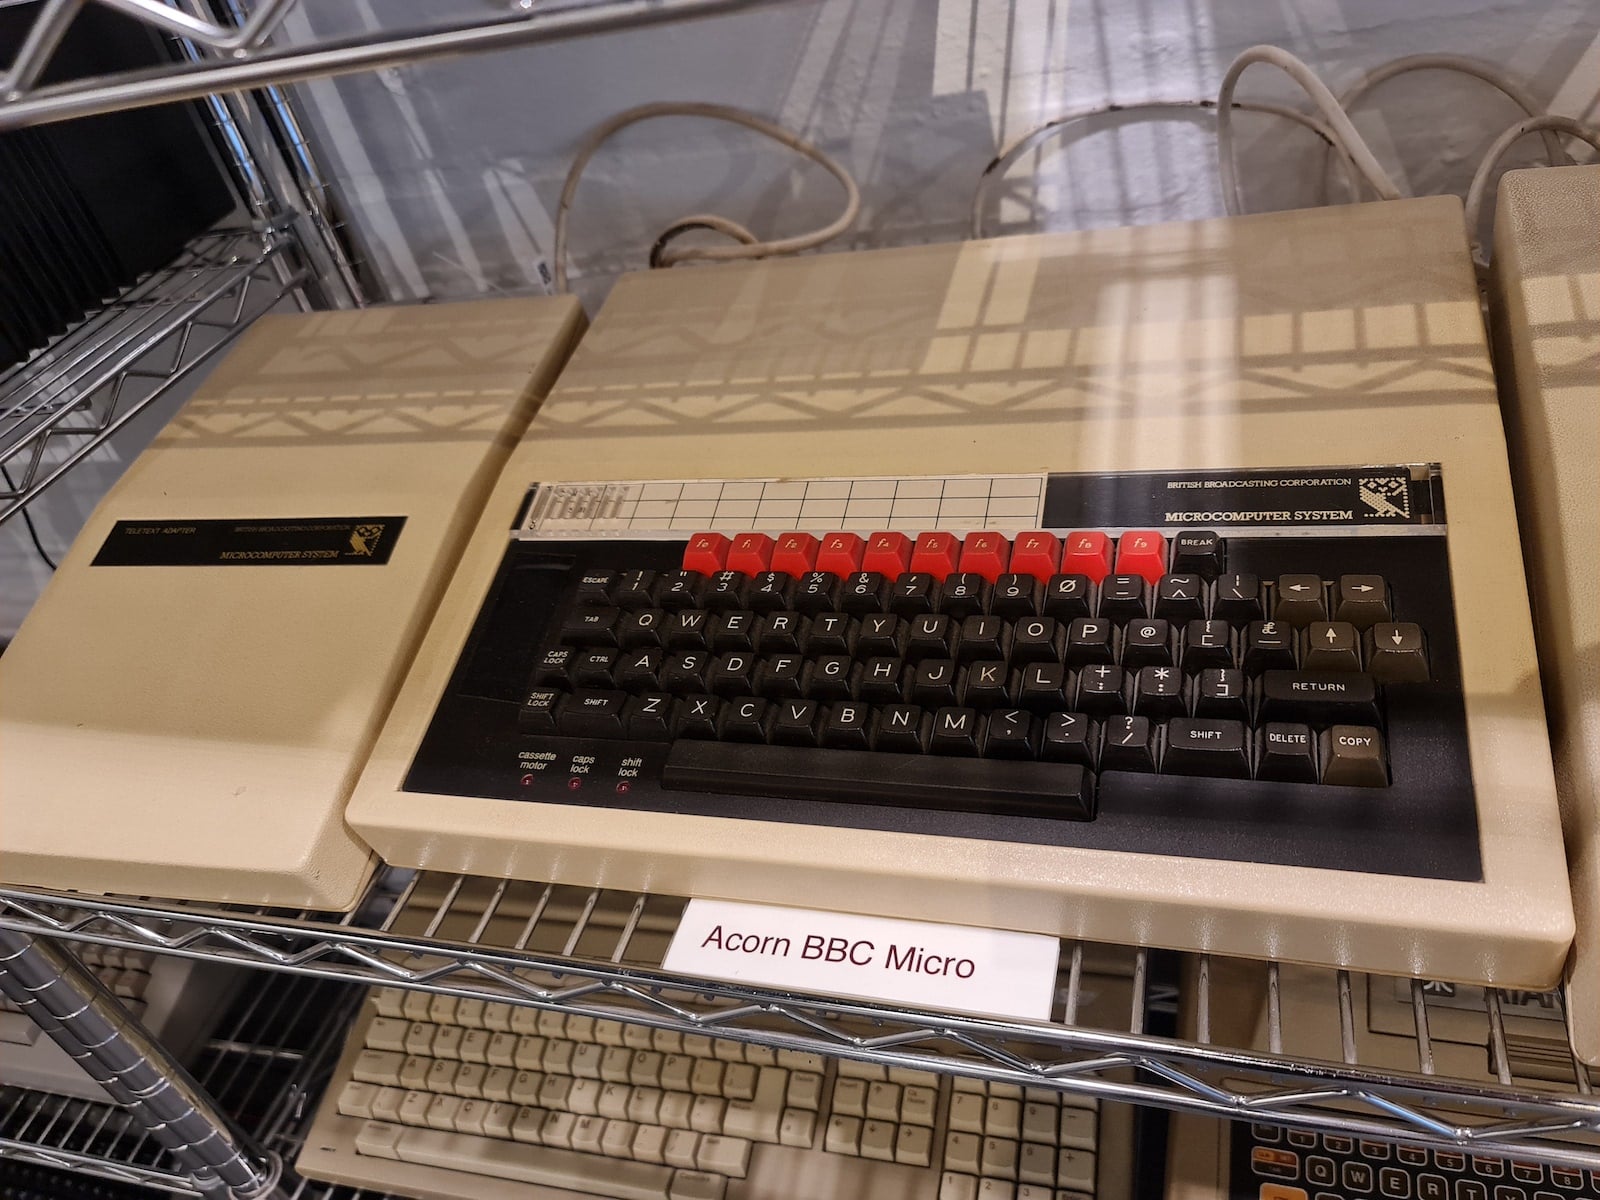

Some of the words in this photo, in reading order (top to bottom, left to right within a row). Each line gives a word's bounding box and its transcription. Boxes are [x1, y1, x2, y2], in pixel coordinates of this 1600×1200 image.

[1167, 481, 1202, 489] BRITISH
[1204, 480, 1278, 488] BROADCASTING
[1280, 478, 1351, 487] CORPORATION
[1165, 511, 1291, 522] MICROCOMPUTER
[1294, 510, 1353, 520] SYSTEM
[1181, 538, 1213, 546] BREAK
[219, 551, 301, 560] MICROCOMPUTER
[302, 550, 340, 559] SYSTEM
[767, 573, 775, 582] $
[812, 573, 824, 583] %
[858, 573, 869, 583] &
[671, 582, 683, 592] 2
[717, 583, 728, 592] 3
[761, 583, 772, 593] 4
[807, 584, 818, 593] 5
[855, 584, 866, 594] 6
[906, 586, 917, 595] 7
[954, 586, 967, 596] 8
[1006, 587, 1020, 597] 9
[638, 614, 652, 626] Q
[682, 615, 701, 627] W
[727, 616, 743, 629] E
[773, 617, 789, 630] R
[824, 618, 838, 631] T
[872, 619, 886, 632] Y
[923, 620, 938, 634] U
[1027, 622, 1044, 637] O
[1082, 624, 1098, 638] P
[1140, 626, 1156, 638] @
[1261, 622, 1277, 635] £
[589, 655, 609, 663] CTRL
[634, 655, 650, 667] A
[682, 656, 697, 669] S
[727, 657, 743, 671] D
[775, 660, 791, 673] F
[825, 661, 840, 675] G
[873, 663, 892, 677] H
[928, 665, 944, 680] J
[980, 666, 997, 682] K
[1036, 668, 1051, 683] L
[1292, 682, 1346, 692] RETURN
[530, 692, 554, 700] SHIFT
[583, 698, 609, 706] SHIFT
[527, 699, 549, 707] LOCK
[642, 698, 661, 712] Z
[690, 700, 708, 714] X
[740, 703, 755, 717] C
[791, 705, 807, 720] V
[840, 708, 855, 723] B
[891, 711, 909, 726] N
[944, 713, 966, 730] M
[1190, 730, 1222, 740] SHIFT
[1269, 733, 1307, 743] DELETE
[1339, 736, 1371, 747] COPY
[518, 750, 556, 761] cassette
[572, 754, 595, 765] caps
[520, 760, 547, 770] motor
[622, 757, 642, 767] shift
[570, 764, 590, 774] lock
[618, 767, 638, 777] lock
[702, 925, 791, 957] Acorn
[800, 935, 876, 966] BBC
[885, 944, 975, 979] Micro
[1409, 1154, 1416, 1162] 4
[1314, 1165, 1327, 1177] Q
[1484, 1165, 1491, 1173] 6
[1523, 1170, 1531, 1179] 7
[1350, 1169, 1366, 1184] W
[1563, 1176, 1571, 1185] 8
[985, 1181, 992, 1190] 2
[1389, 1177, 1401, 1190] E
[1426, 1183, 1439, 1197] R
[1466, 1188, 1478, 1200] T
